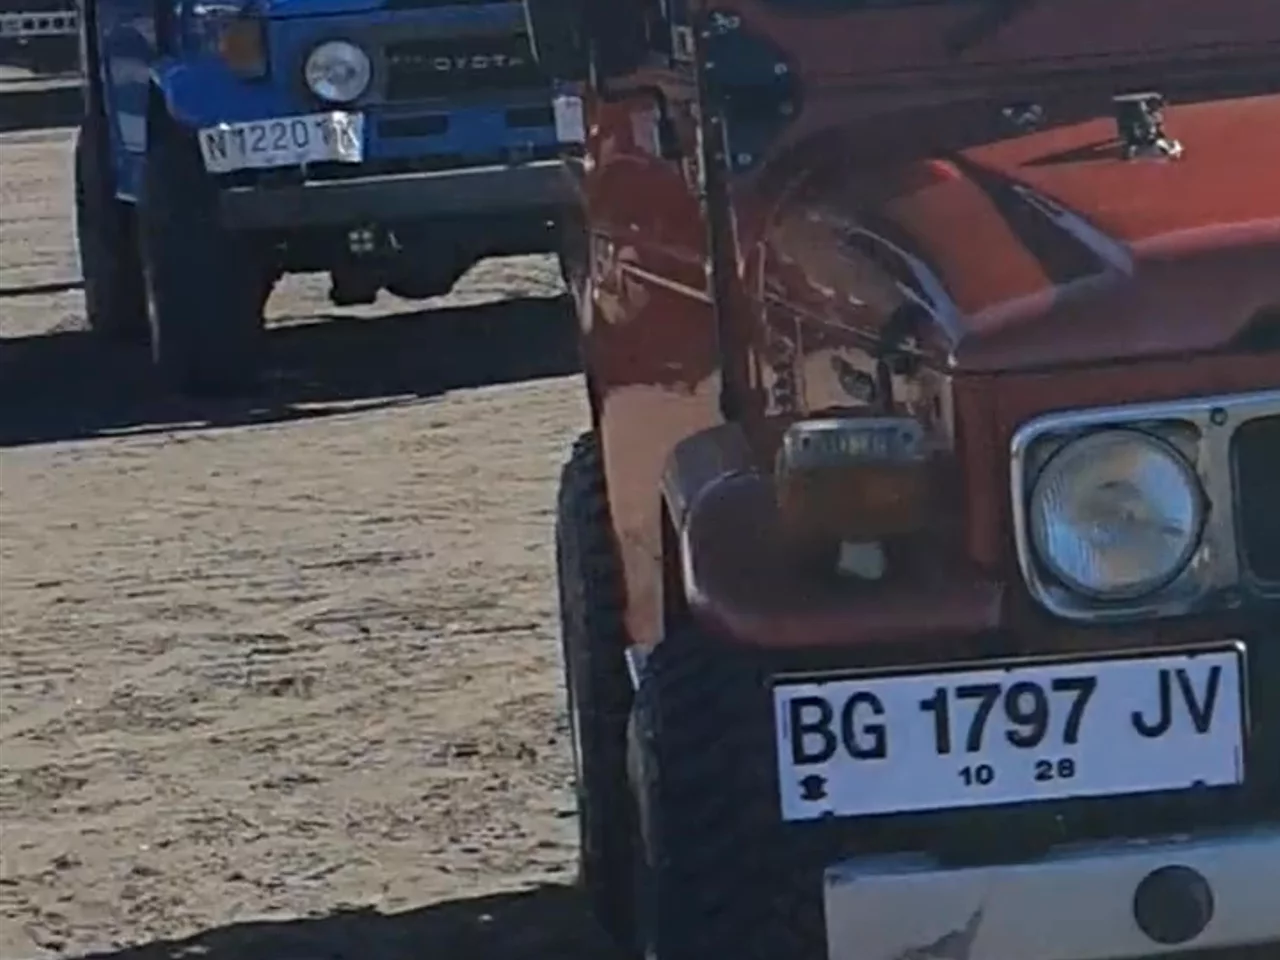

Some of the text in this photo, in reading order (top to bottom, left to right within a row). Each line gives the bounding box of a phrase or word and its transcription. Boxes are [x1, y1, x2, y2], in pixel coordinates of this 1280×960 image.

[233, 119, 310, 158] 1220
[789, 665, 1222, 766] BG 1797 JV
[958, 757, 1077, 787] 10 28
